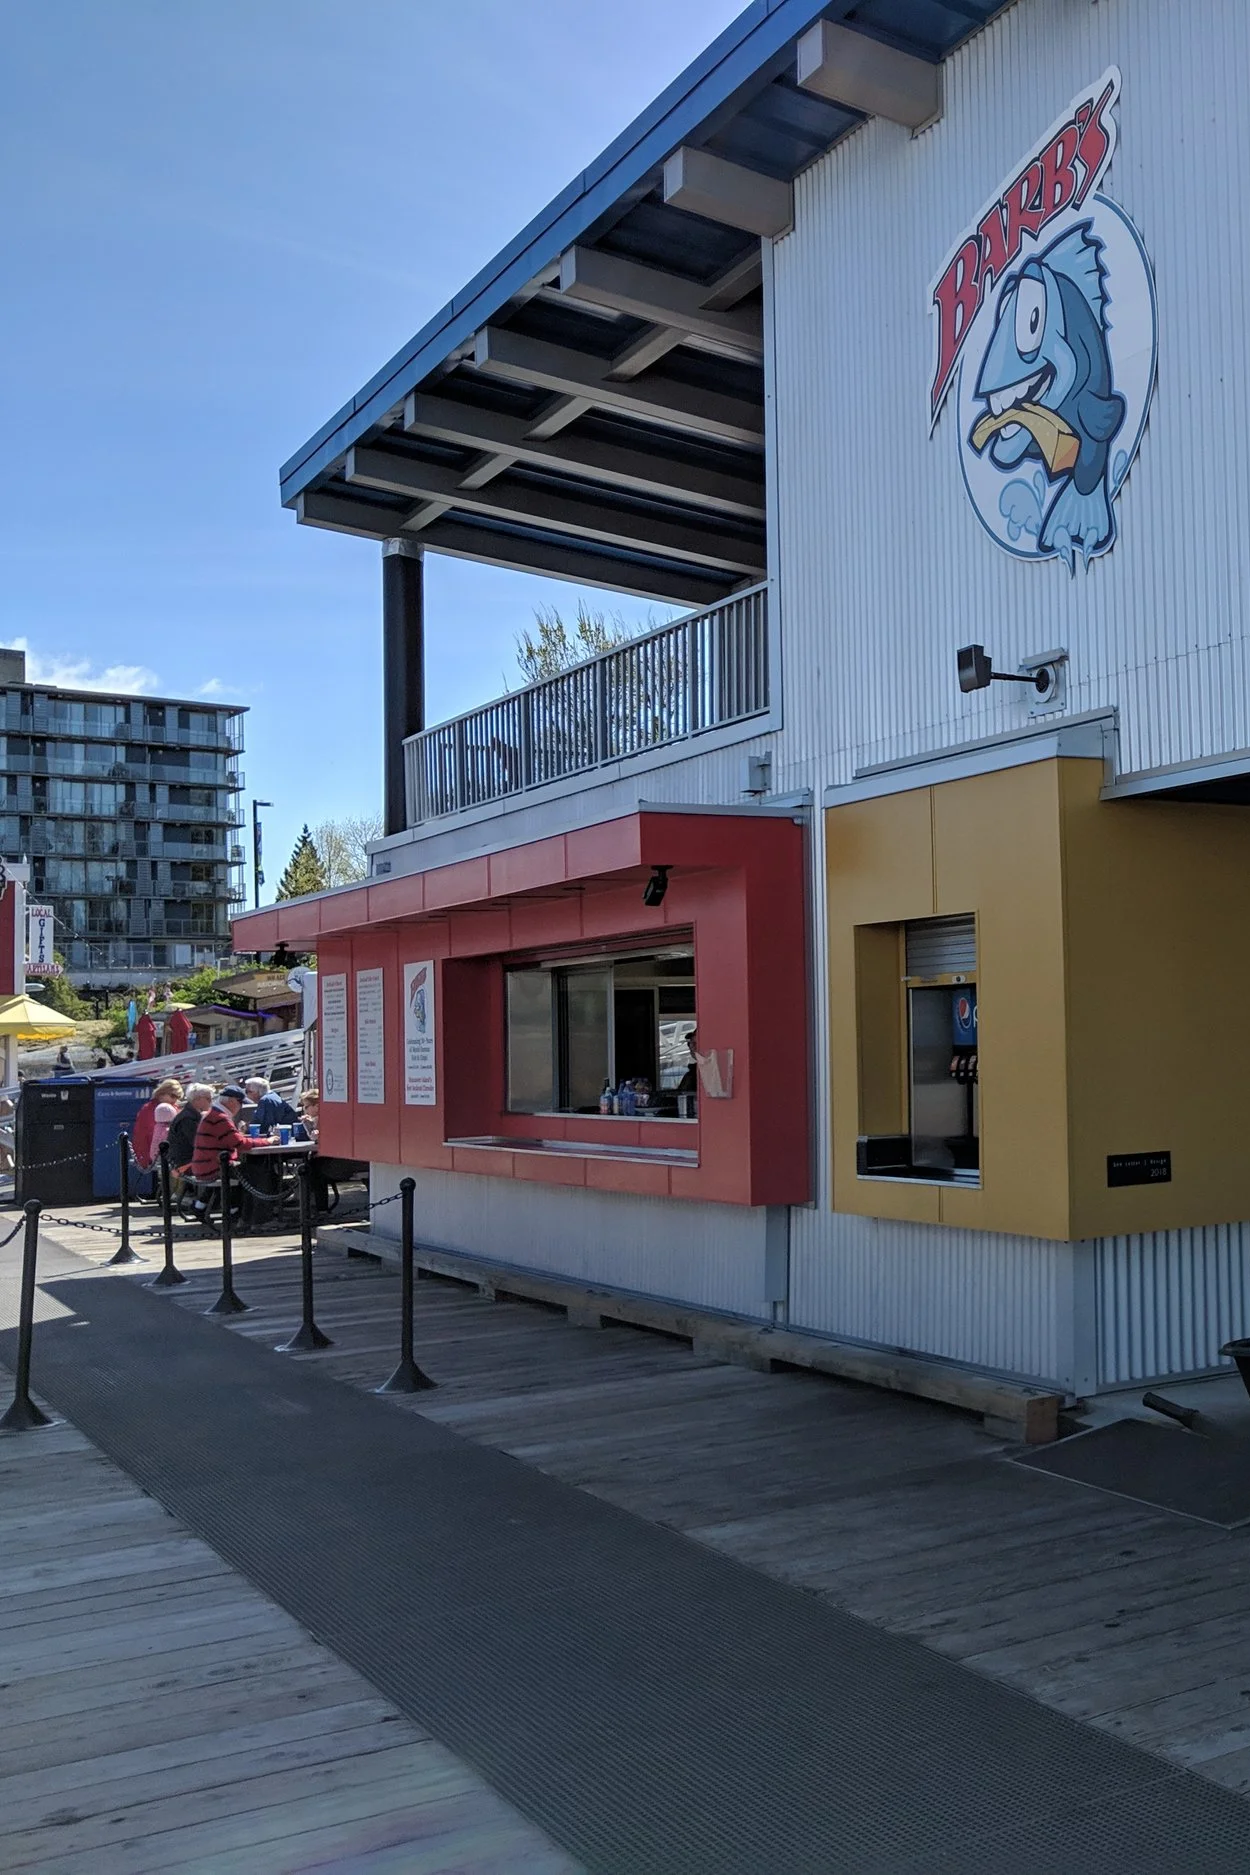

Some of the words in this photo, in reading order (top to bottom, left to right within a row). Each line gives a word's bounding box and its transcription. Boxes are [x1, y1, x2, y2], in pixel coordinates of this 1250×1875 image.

[931, 79, 1115, 414] BARB'S
[31, 907, 52, 918] LOCAL
[38, 918, 46, 963] GIFTS
[1150, 1167, 1167, 1177] 2018
